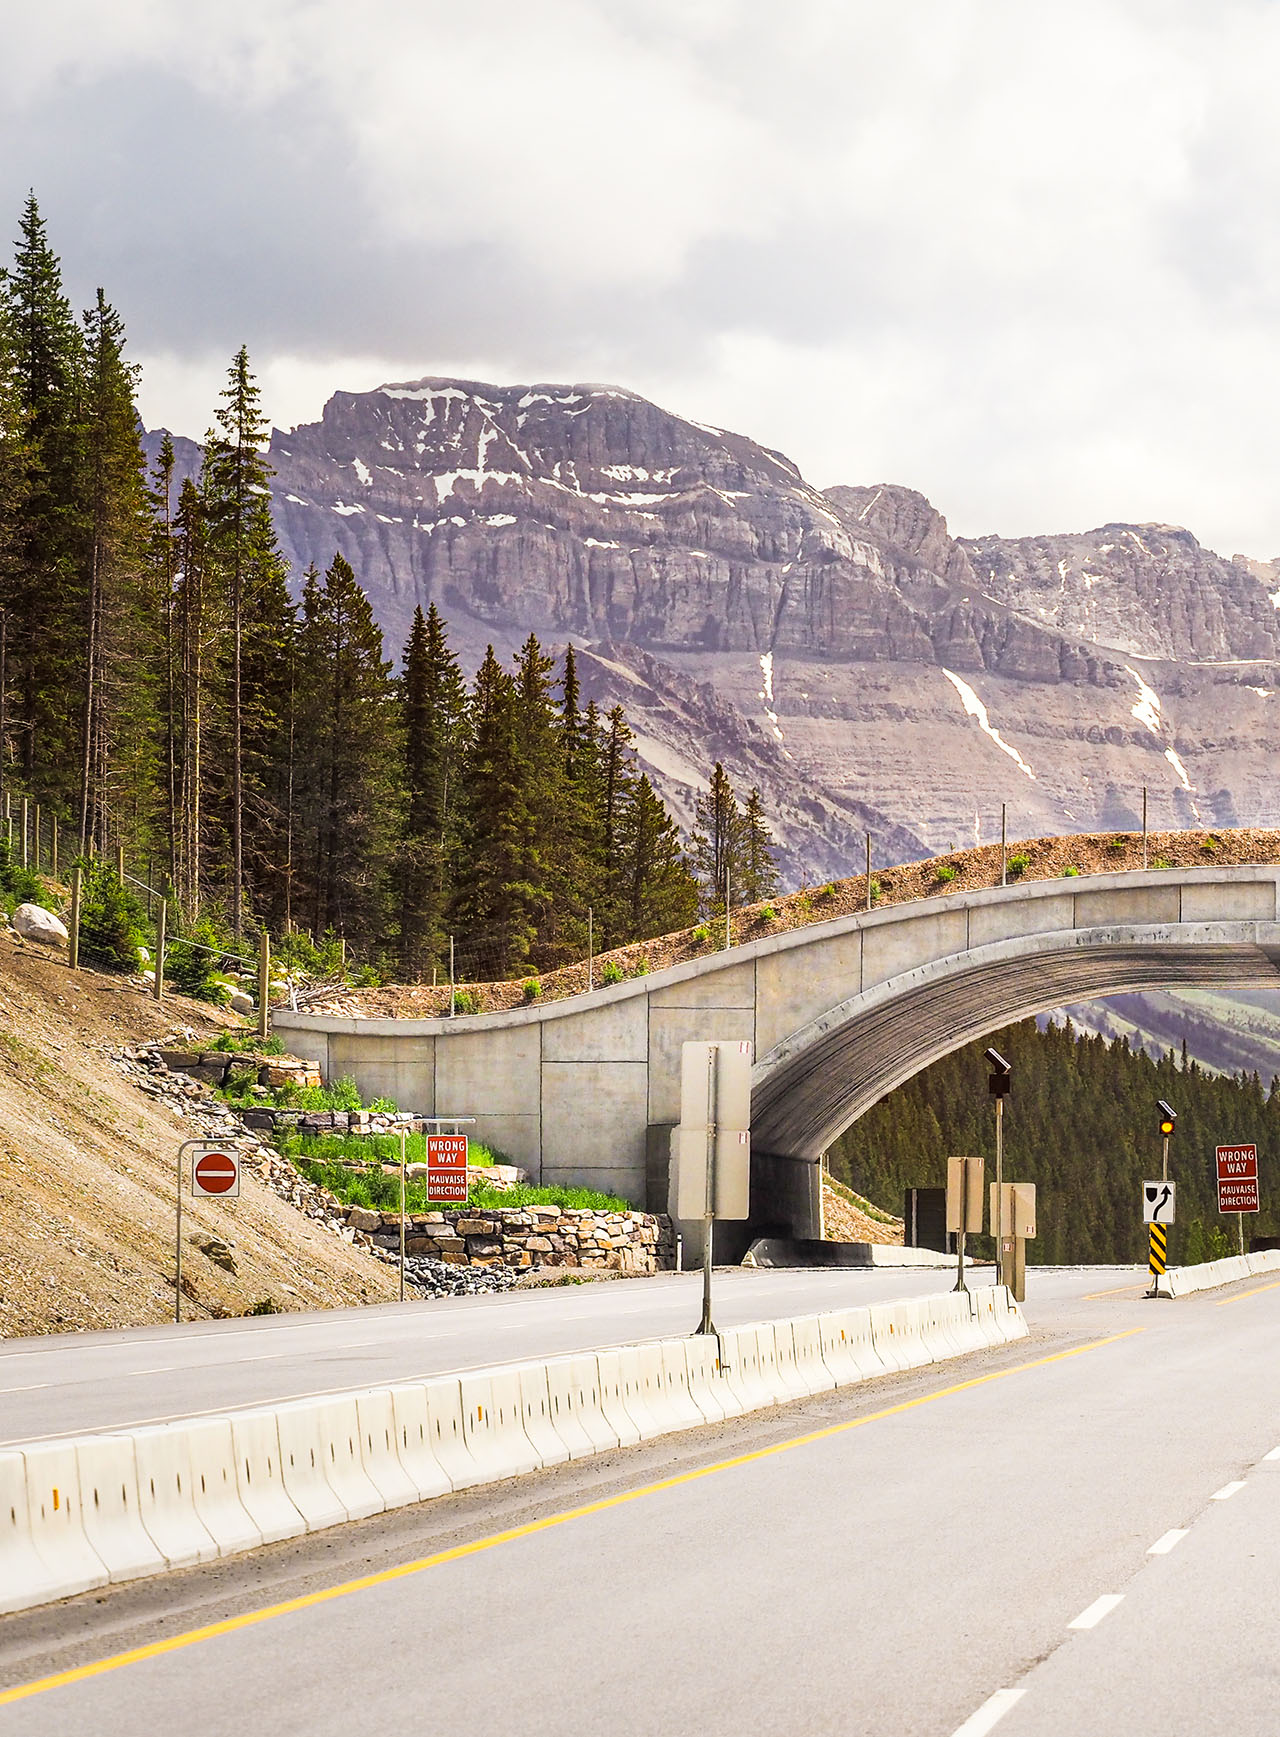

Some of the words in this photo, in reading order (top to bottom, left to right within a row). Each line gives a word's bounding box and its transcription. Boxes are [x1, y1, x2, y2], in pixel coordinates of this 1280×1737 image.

[429, 1140, 465, 1152] WRONG
[437, 1152, 458, 1164] WAY
[1219, 1150, 1255, 1163] WRONG
[1227, 1162, 1247, 1174] WAY
[429, 1175, 465, 1184] MAUVAISE
[429, 1186, 466, 1195] DIRECTION
[1221, 1184, 1256, 1195] MAUVAISE
[1220, 1196, 1257, 1206] DIRECTION
